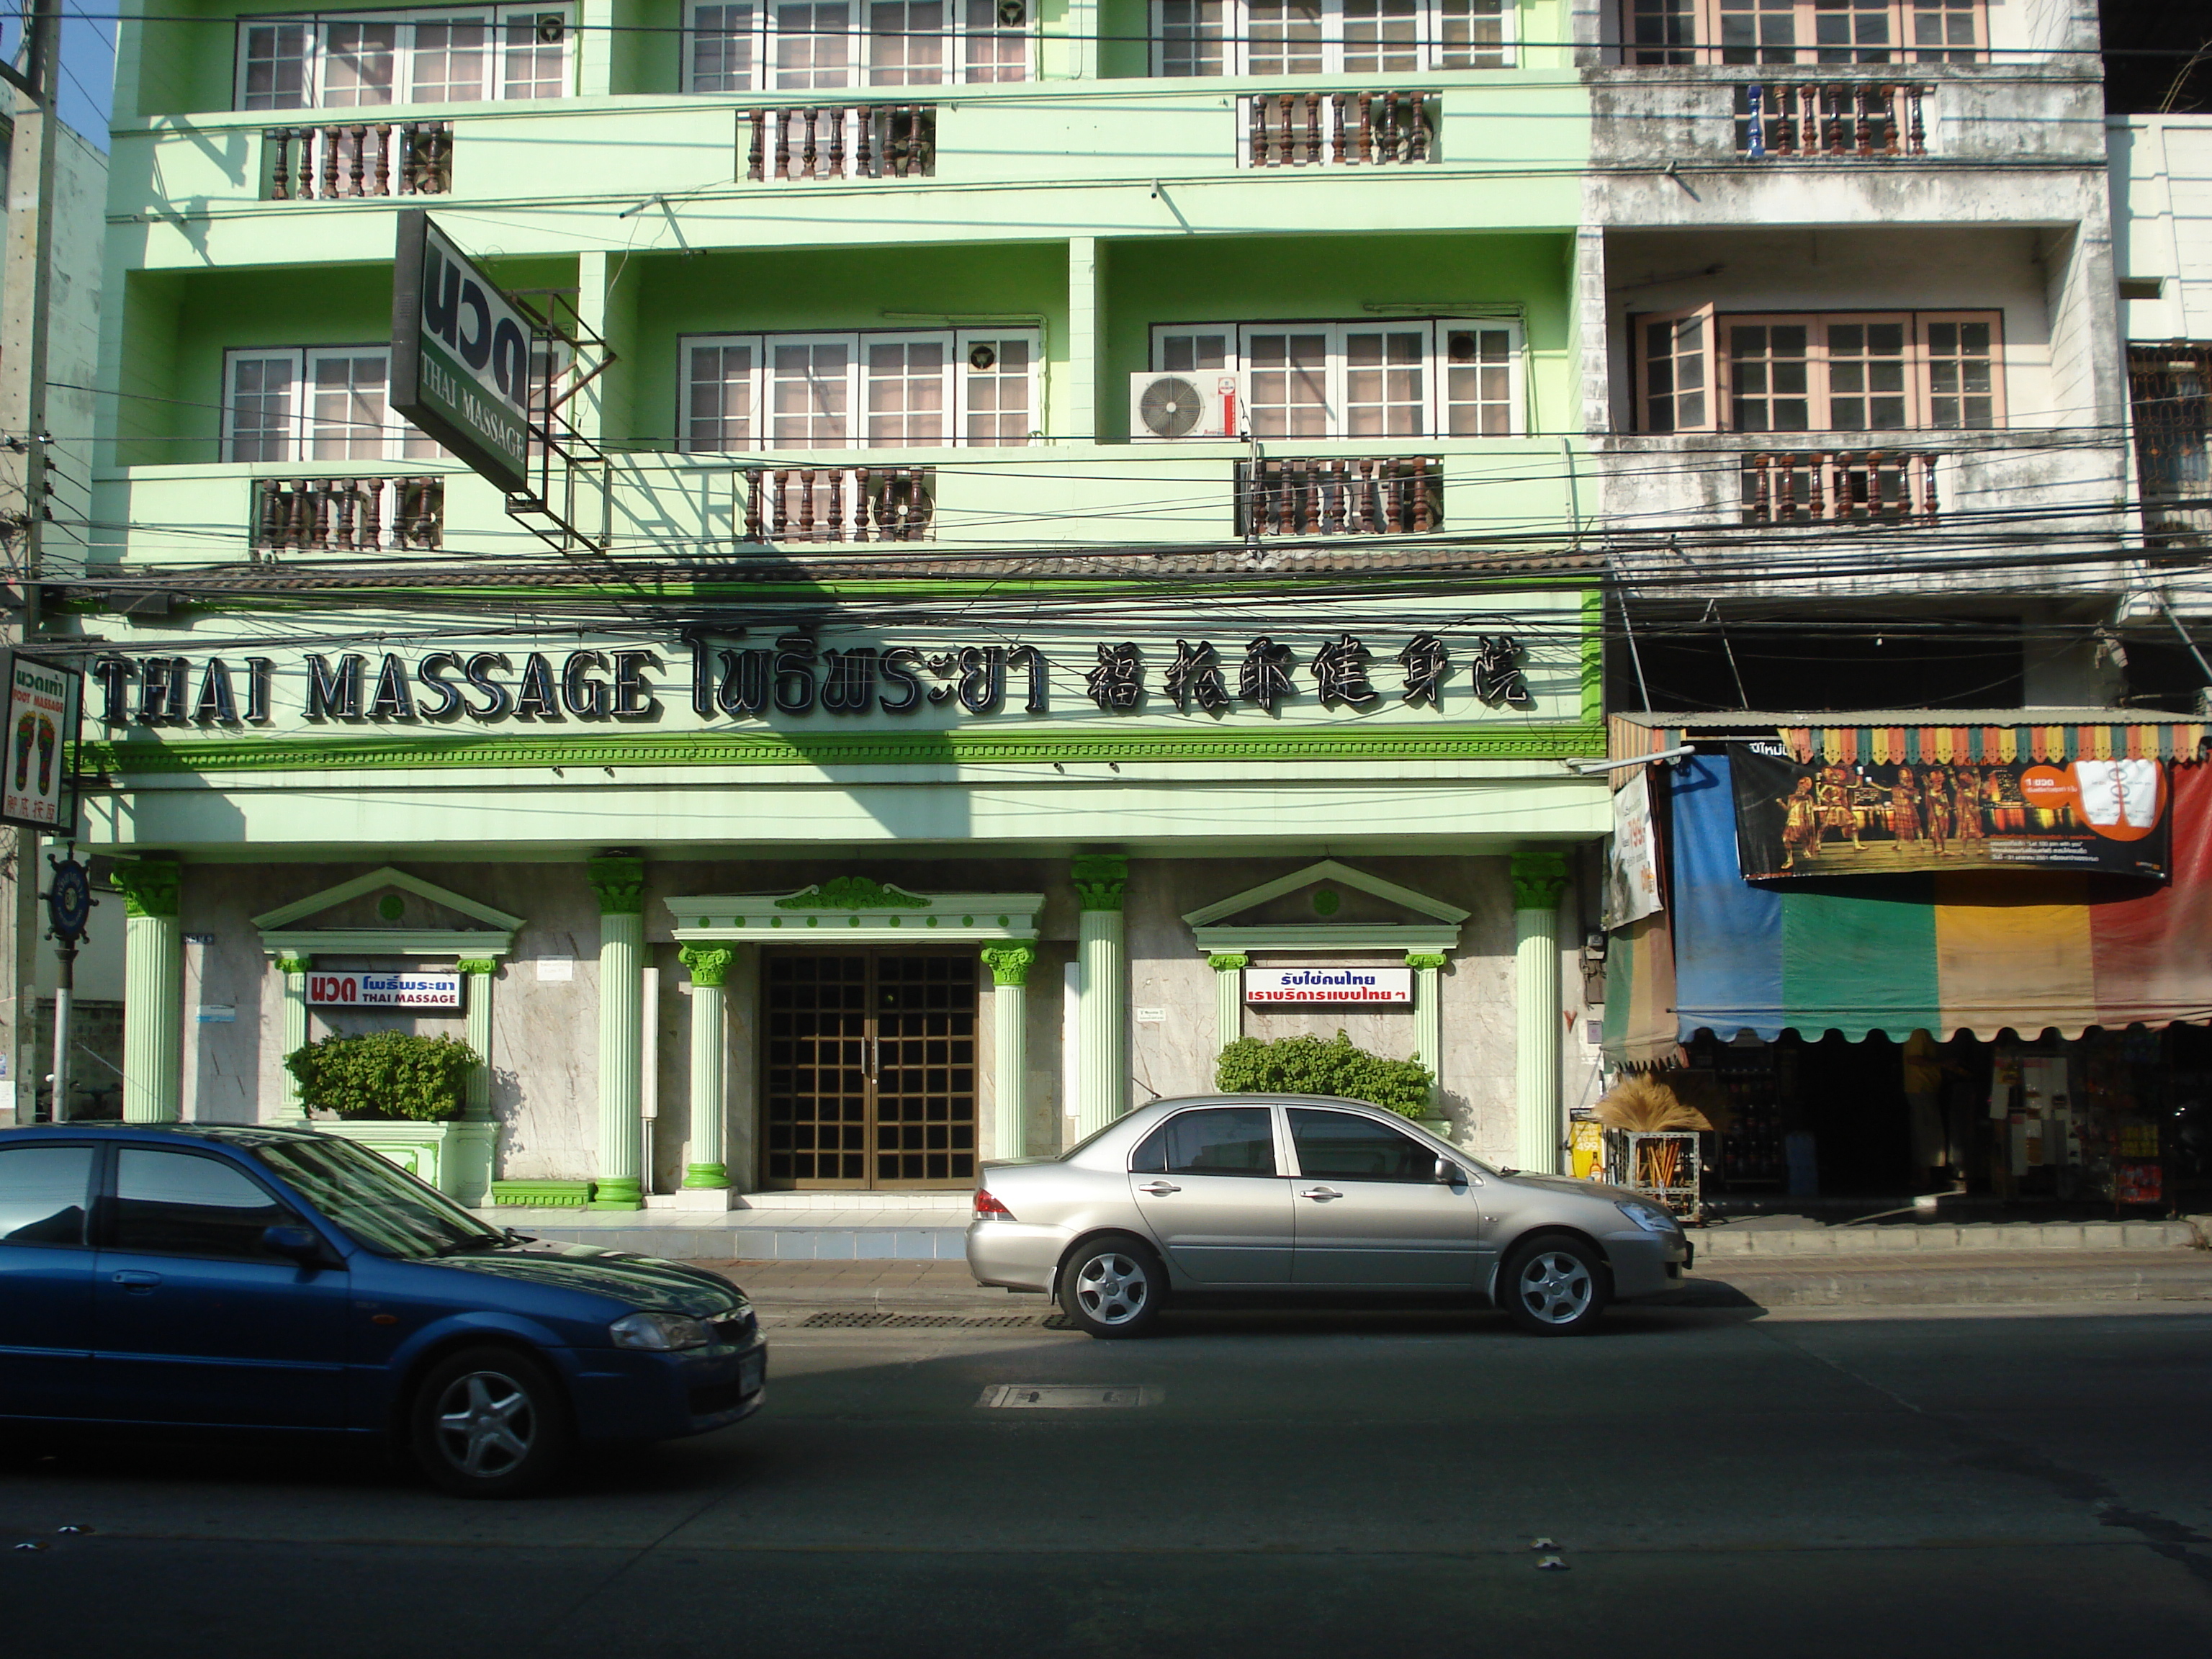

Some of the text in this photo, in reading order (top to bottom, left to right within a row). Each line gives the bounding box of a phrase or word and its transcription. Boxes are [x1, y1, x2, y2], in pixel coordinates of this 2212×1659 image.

[424, 242, 526, 409] นวด
[421, 353, 525, 464] THAI MASSAGE
[16, 669, 63, 697] นวดเท้า
[94, 649, 657, 722] THAI MASSAGE
[12, 688, 63, 713] FOOT MASSAGE
[310, 976, 357, 1002] นวด
[362, 975, 455, 991] โพธิ์พระยา
[1280, 971, 1376, 986] รับใช้คนไทย
[362, 994, 455, 1004] THAI MASSAGE
[1249, 986, 1392, 1001] เราบริการแบบไทย
